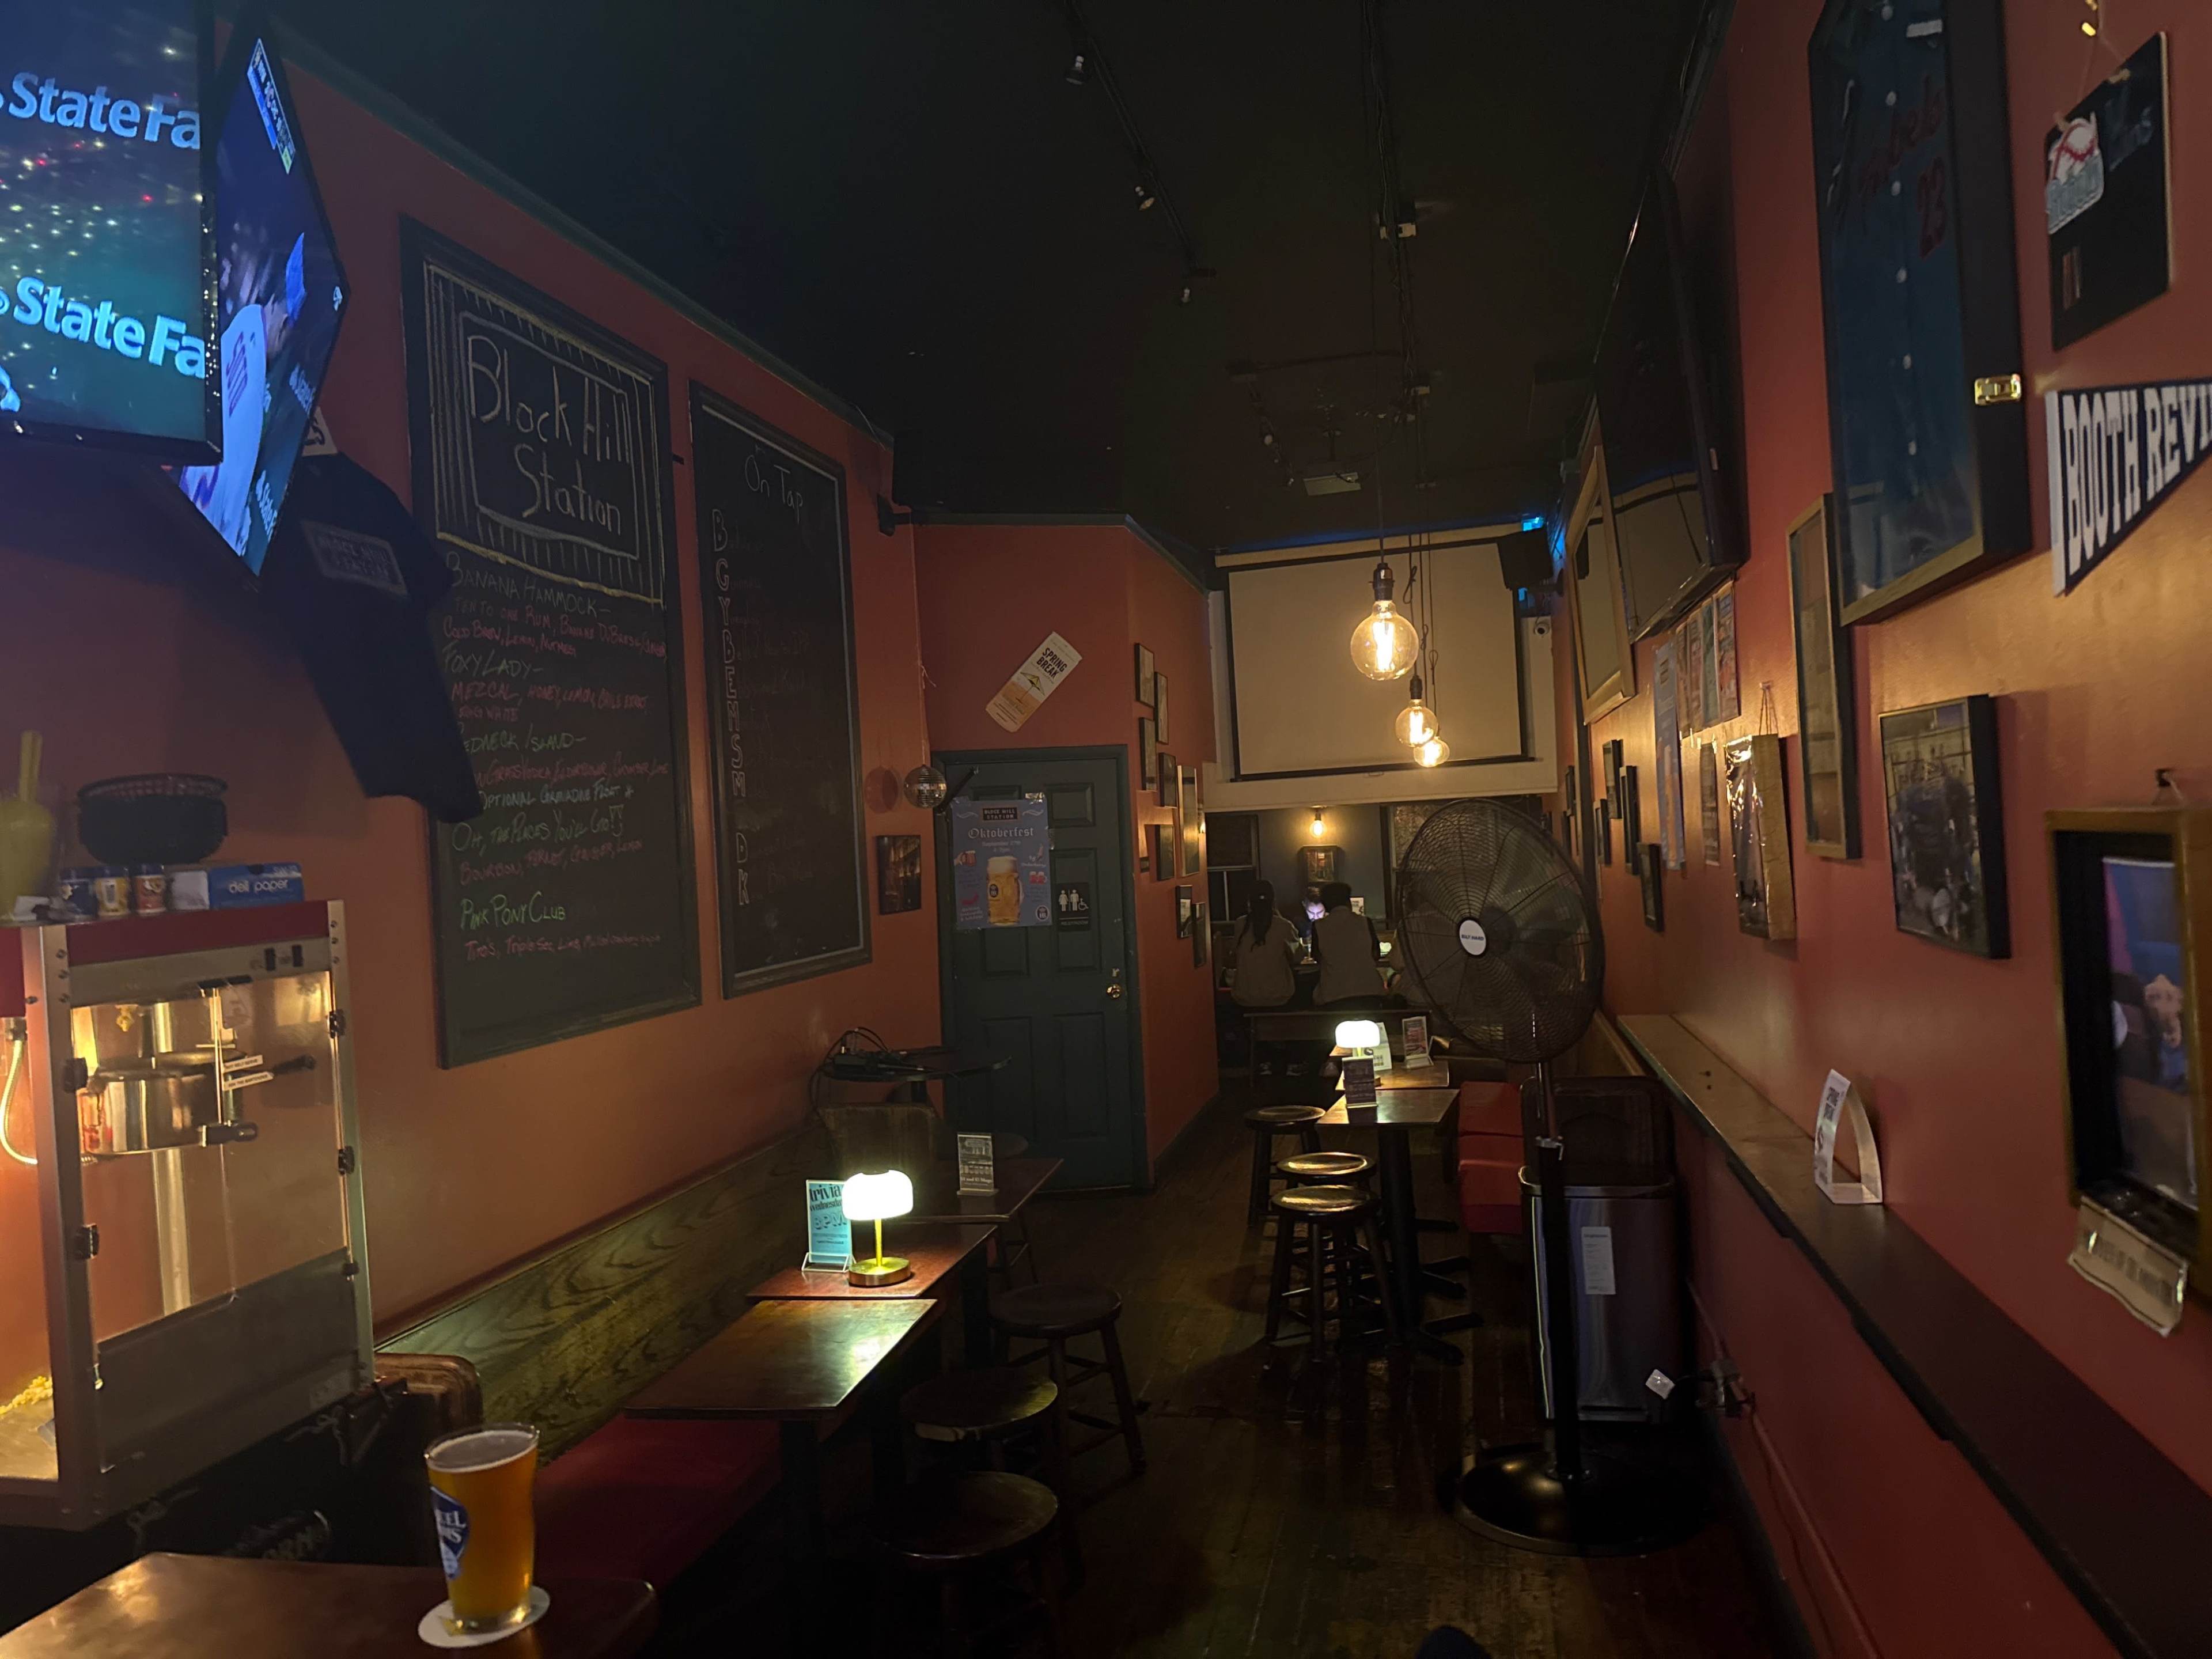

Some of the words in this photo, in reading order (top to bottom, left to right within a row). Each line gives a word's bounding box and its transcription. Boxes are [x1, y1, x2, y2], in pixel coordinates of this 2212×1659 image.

[583, 376, 629, 464] Hill
[514, 442, 621, 536] Station
[745, 454, 770, 498] On
[774, 464, 803, 524] Tap
[2062, 389, 2141, 576] BOOTH
[446, 551, 518, 599] BANANA
[442, 640, 481, 676] FOXY
[1036, 656, 1060, 679] BREAK
[1042, 647, 1067, 673] SPRING
[968, 827, 1035, 839] Oktoberfest
[253, 878, 289, 893] paper
[460, 897, 489, 931] PINK
[490, 893, 527, 927] PONY
[529, 890, 566, 922] CLUB
[809, 1184, 842, 1202] trivia
[809, 1198, 842, 1211] wednesda
